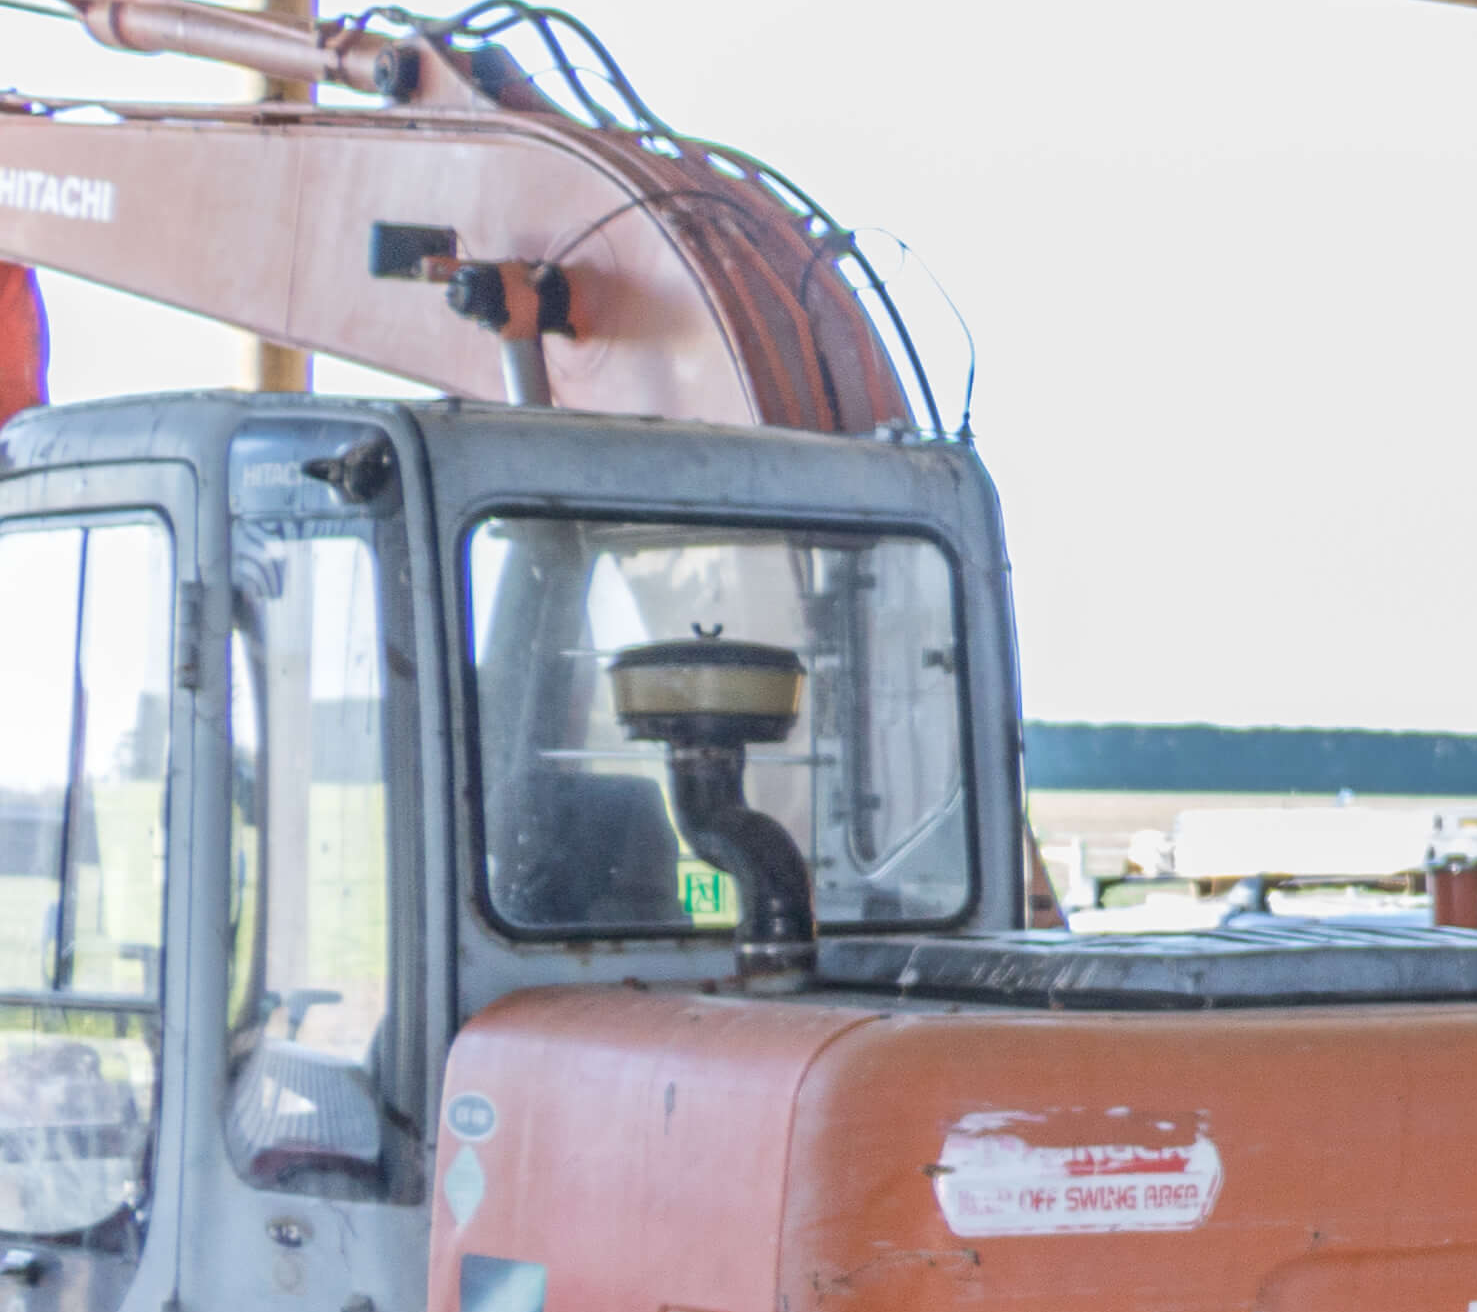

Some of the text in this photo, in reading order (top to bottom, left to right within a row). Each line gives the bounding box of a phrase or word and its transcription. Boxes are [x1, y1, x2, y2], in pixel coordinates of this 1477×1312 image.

[0, 165, 114, 222] HITACHI
[1064, 1186, 1138, 1211] SWING
[1143, 1183, 1200, 1208] AREA
